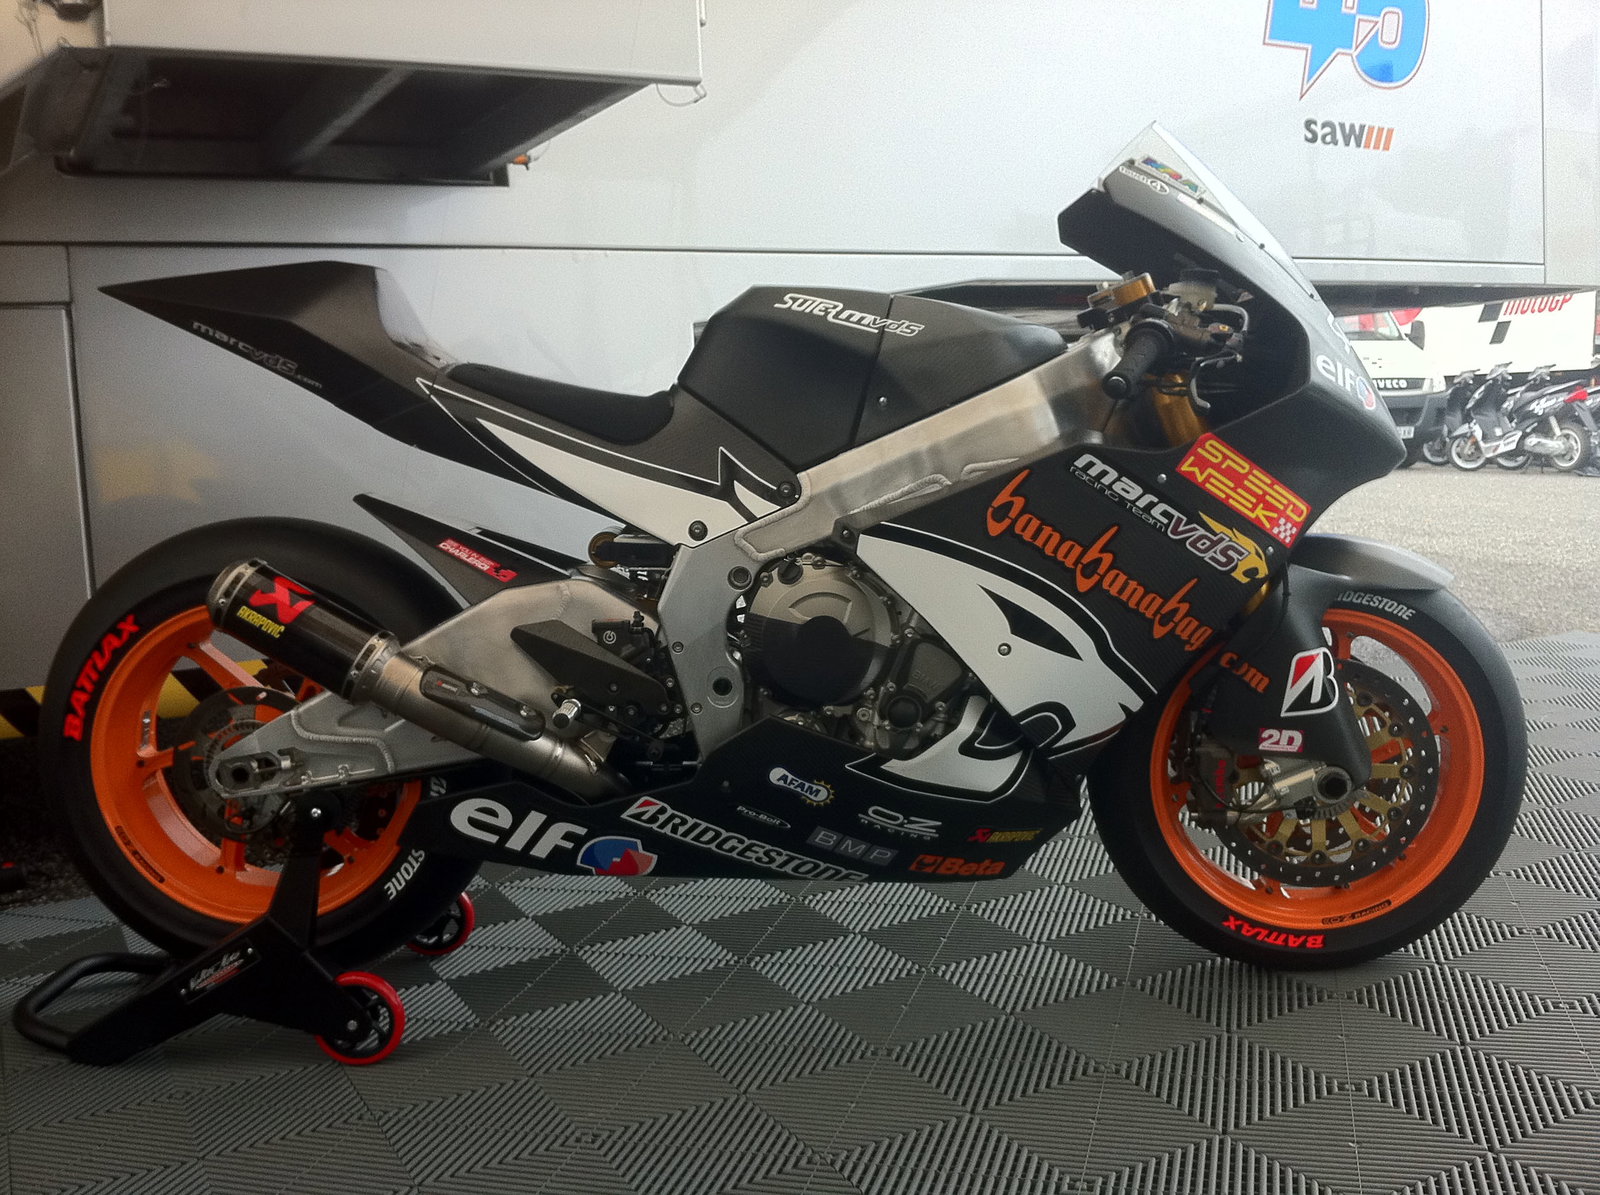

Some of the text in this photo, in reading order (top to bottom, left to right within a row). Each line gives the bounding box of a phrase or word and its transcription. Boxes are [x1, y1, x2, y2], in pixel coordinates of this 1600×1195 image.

[1180, 455, 1279, 529] WEEK
[1196, 439, 1309, 523] SPEED
[1258, 729, 1303, 751] 2D
[776, 773, 822, 798] AFAM
[449, 798, 589, 859] elf
[813, 829, 893, 861] BMP
[938, 858, 1006, 876] Beta
